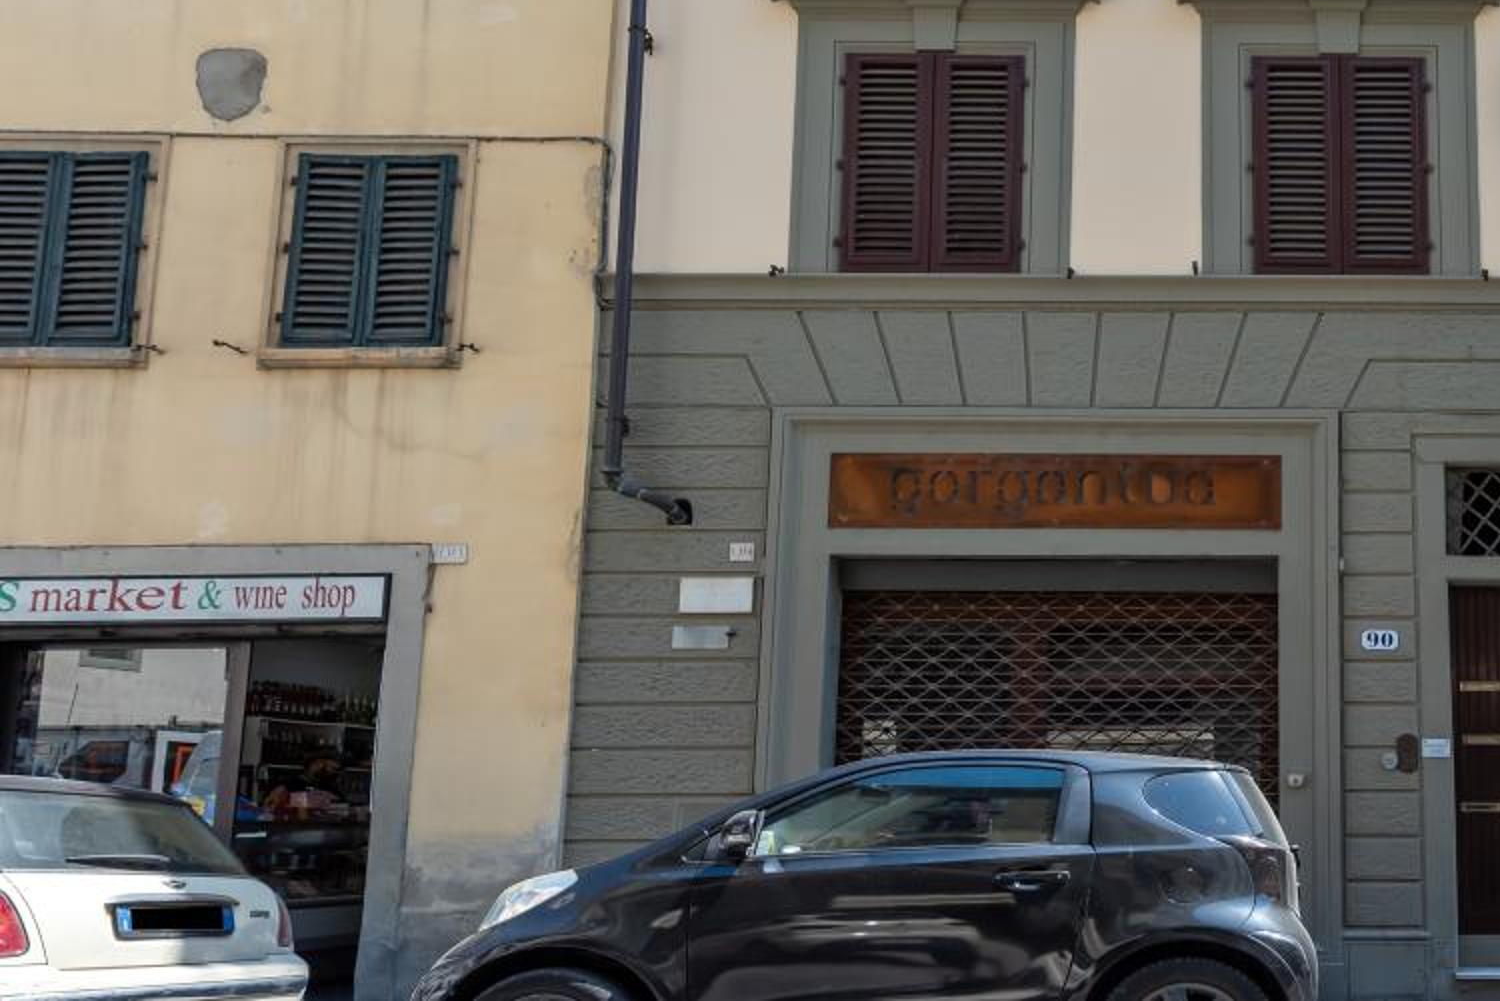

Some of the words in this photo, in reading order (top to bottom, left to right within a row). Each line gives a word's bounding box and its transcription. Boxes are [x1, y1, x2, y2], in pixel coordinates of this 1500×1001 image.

[30, 578, 188, 612] market
[197, 580, 221, 610] &
[234, 583, 287, 610] wine
[301, 576, 355, 617] shop
[1367, 631, 1393, 648] 90
